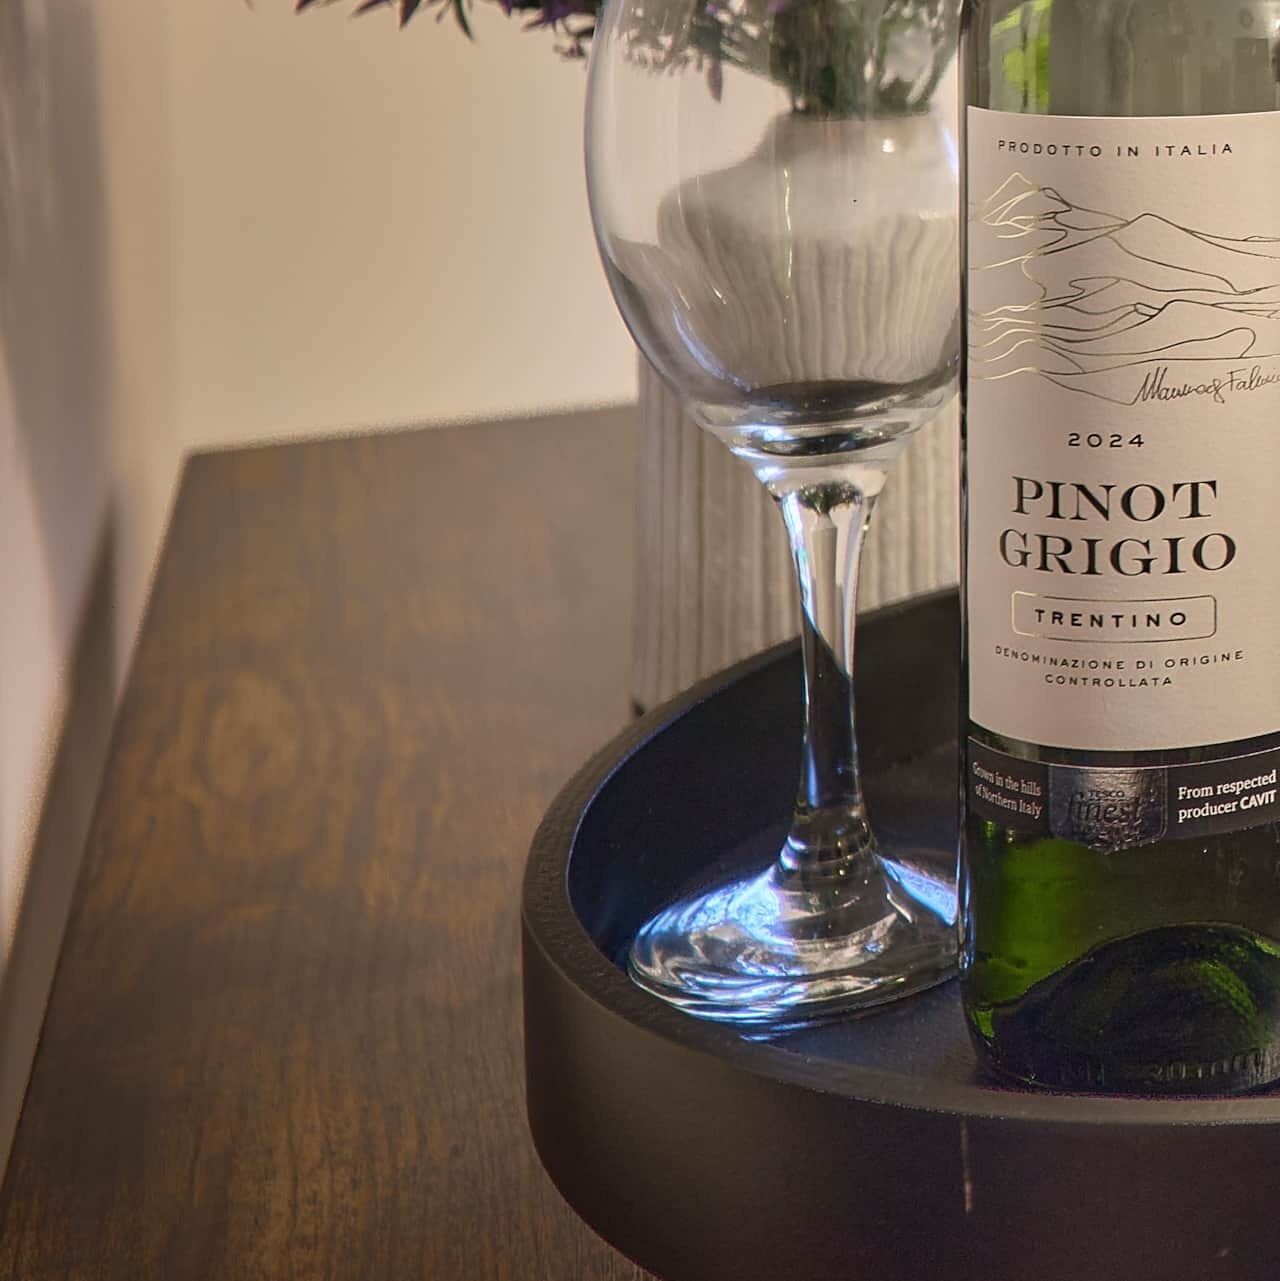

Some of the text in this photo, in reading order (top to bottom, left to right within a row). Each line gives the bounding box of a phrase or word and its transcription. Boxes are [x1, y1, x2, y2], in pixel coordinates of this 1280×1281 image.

[998, 140, 1233, 157] PRODOTTO IN ITALIA
[1068, 433, 1145, 448] 2024
[1012, 476, 1217, 522] PINOT
[999, 528, 1237, 576] GRIGIO
[1034, 608, 1187, 628] TRENTINO
[995, 645, 1245, 670] DENOMINAZIONE DI ORIGINE
[1045, 673, 1173, 688] CONTROLLATA
[1021, 779, 1042, 797] hills
[1178, 769, 1277, 800] From respected
[1019, 799, 1043, 819] Italy
[1178, 789, 1277, 823] producer CAVIT
